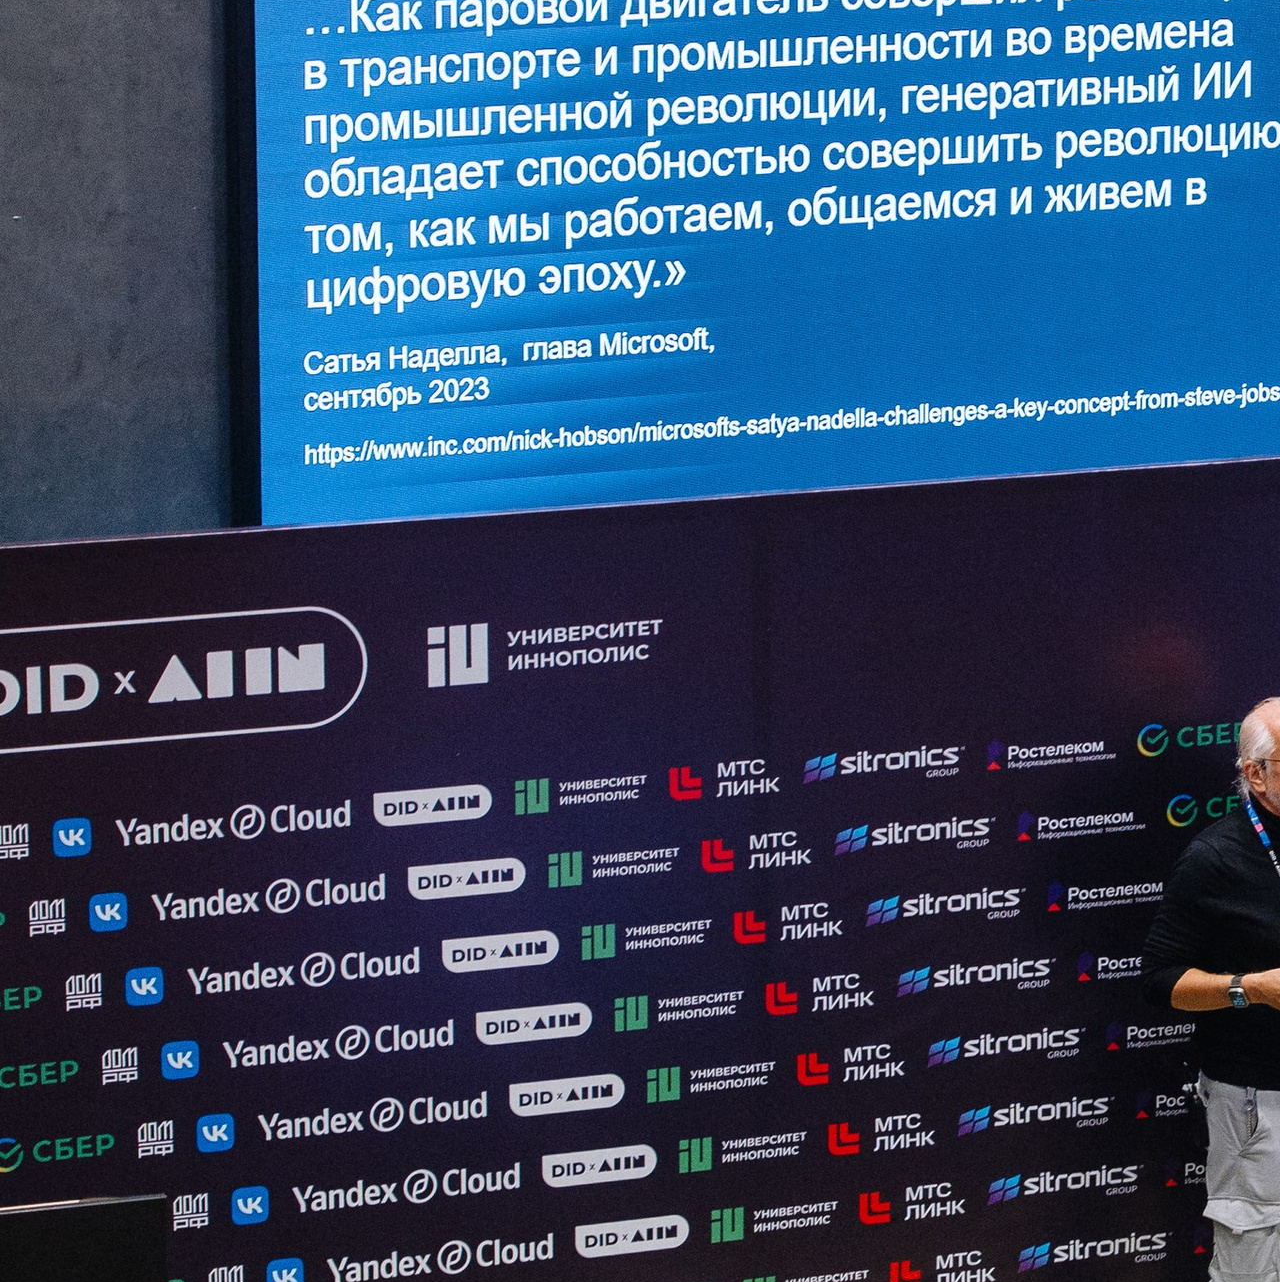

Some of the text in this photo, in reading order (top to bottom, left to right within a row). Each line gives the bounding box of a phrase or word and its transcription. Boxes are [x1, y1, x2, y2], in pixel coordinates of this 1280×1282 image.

[305, 19, 1234, 97] в транспорте и промышленности во времена
[305, 60, 1252, 153] промышленной революции, генеративный ИИ
[305, 156, 504, 200] обладает
[517, 140, 810, 186] способностью
[823, 133, 1042, 175] совершить
[304, 178, 1206, 257] том, как мы работаем, общаемся и живем в
[307, 260, 686, 315] цифровую эпоху.»
[304, 327, 714, 374] Сатья Наделла, глава Microsoft,
[304, 377, 489, 411] сентябрь 2023
[506, 619, 663, 647] УНИВЕРСИТЕТ
[508, 644, 650, 671] ИННОПОЛИС
[840, 745, 961, 775] sitronics
[1007, 740, 1107, 762] Ростелеком
[717, 759, 766, 778] МТС
[925, 767, 960, 778] GROUP
[559, 774, 649, 794] УНИВЕРСИТЕТ
[716, 776, 780, 798] ЛИНК
[559, 788, 640, 806] ИННОПОЛИС
[383, 800, 419, 817] DID
[115, 799, 351, 847] Yandex Cloud
[871, 816, 992, 847] sitronics
[1037, 811, 1136, 833] Ростелеком
[58, 828, 85, 847] VK
[749, 830, 797, 851] МТС
[956, 838, 990, 849] GROUP
[592, 847, 680, 865] УНИВЕРСИТЕТ
[748, 848, 812, 870] ЛИНК
[592, 861, 672, 879] ИННОПОЛИС
[151, 872, 386, 921] Yandex Cloud
[94, 903, 122, 922] VK
[222, 1018, 454, 1069] Yandex Cloud
[32, 1133, 115, 1163] СБЕР
[1023, 1164, 1139, 1197] sitronics
[1105, 1185, 1138, 1196] GROUP
[905, 1182, 952, 1202] МТС
[904, 1199, 966, 1221] ЛИНК
